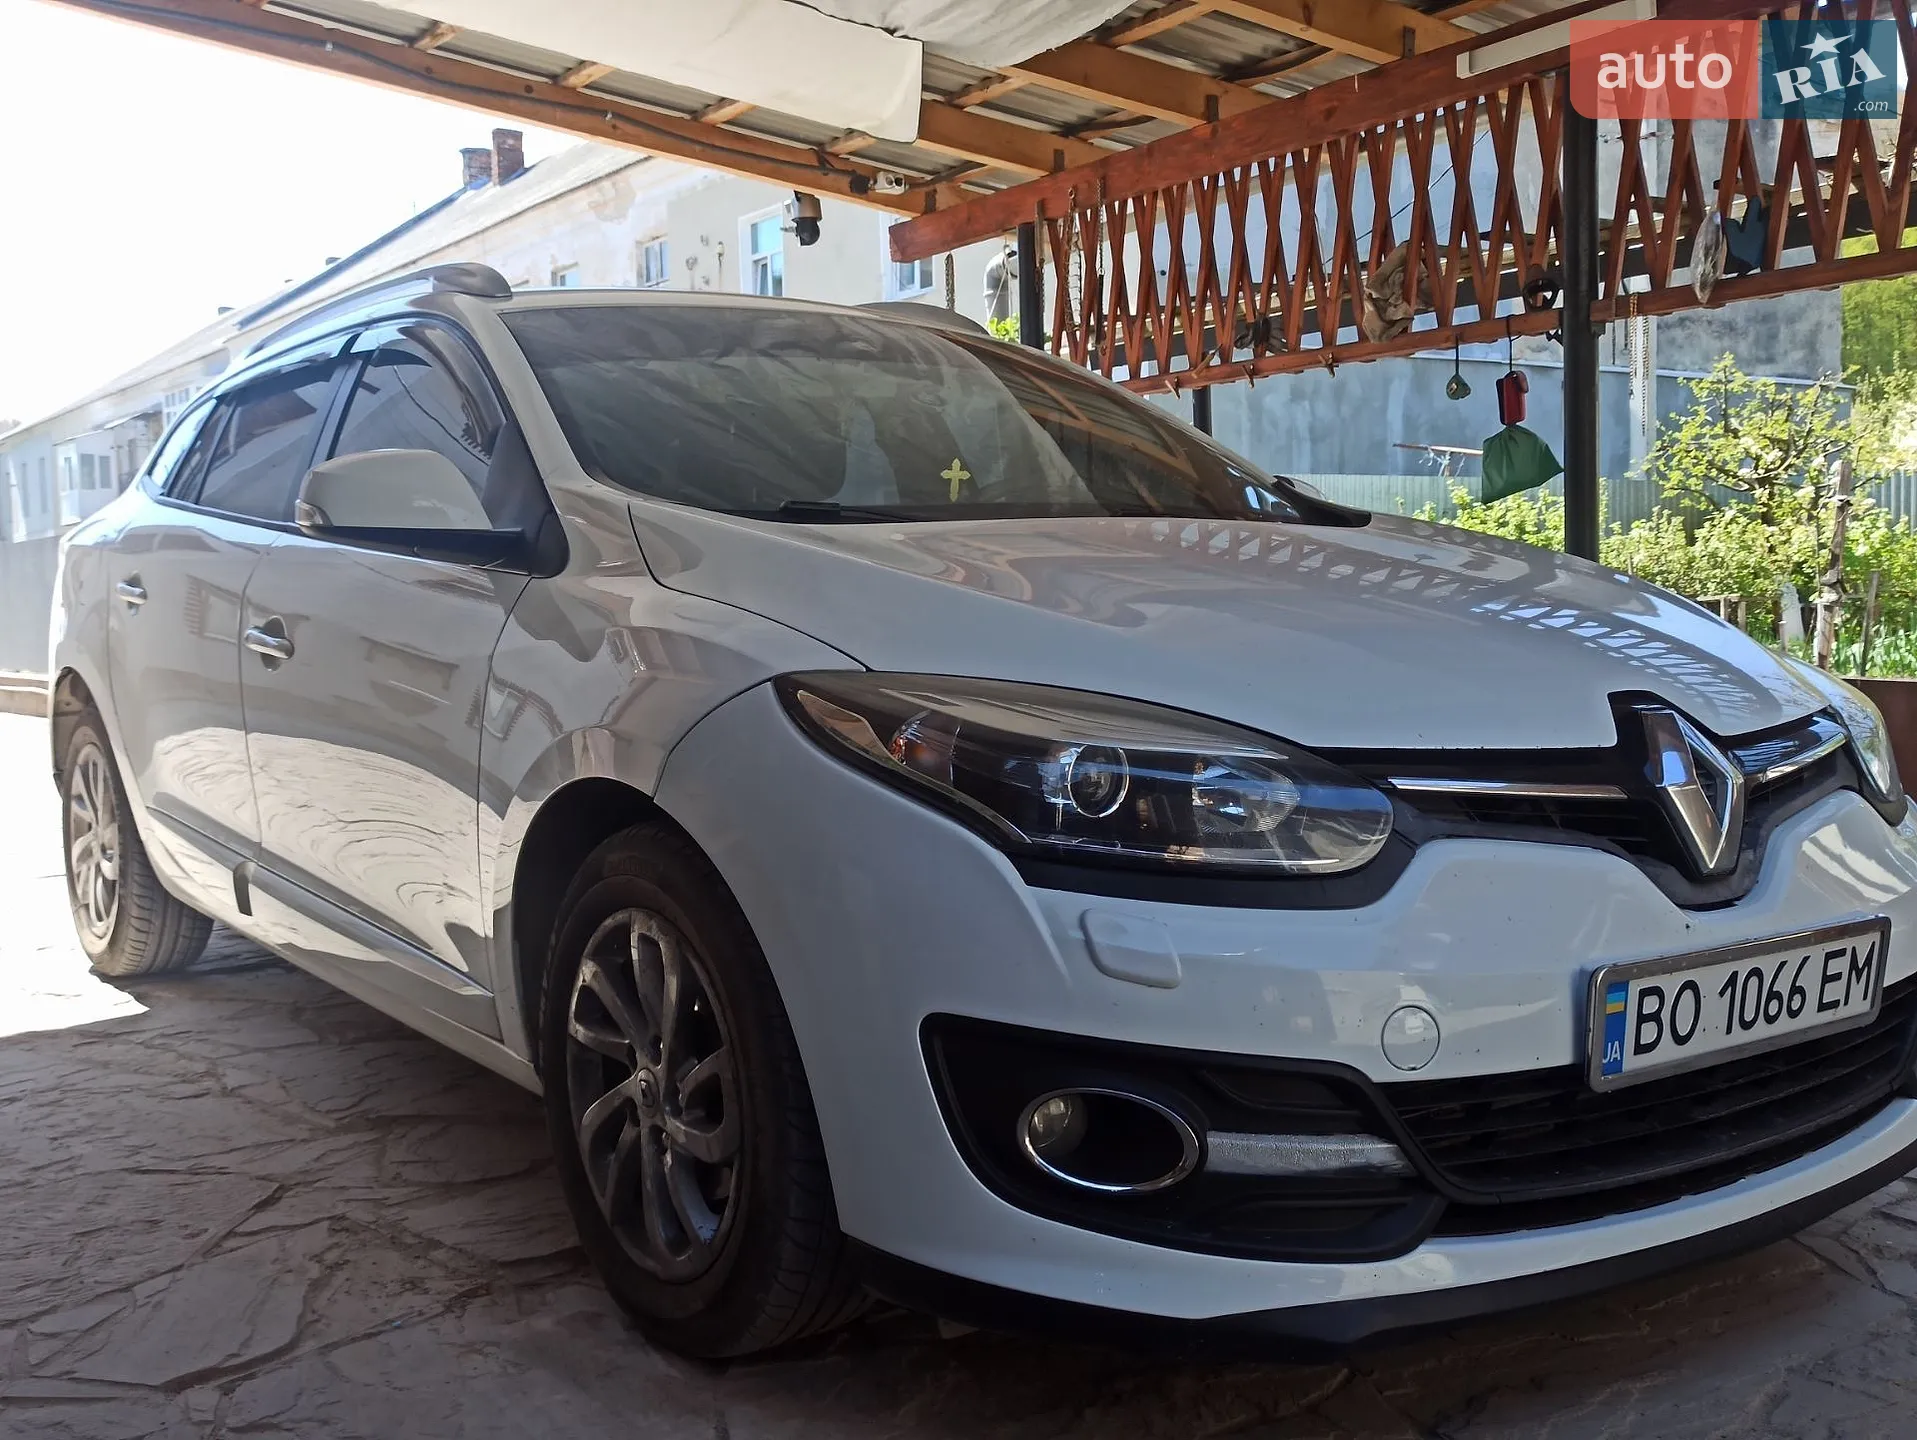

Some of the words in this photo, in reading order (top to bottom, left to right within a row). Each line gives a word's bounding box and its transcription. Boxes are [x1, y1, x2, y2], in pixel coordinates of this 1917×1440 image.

[1633, 979, 1701, 1056] BO
[1718, 954, 1811, 1035] 1066
[1816, 941, 1876, 1013] EM
